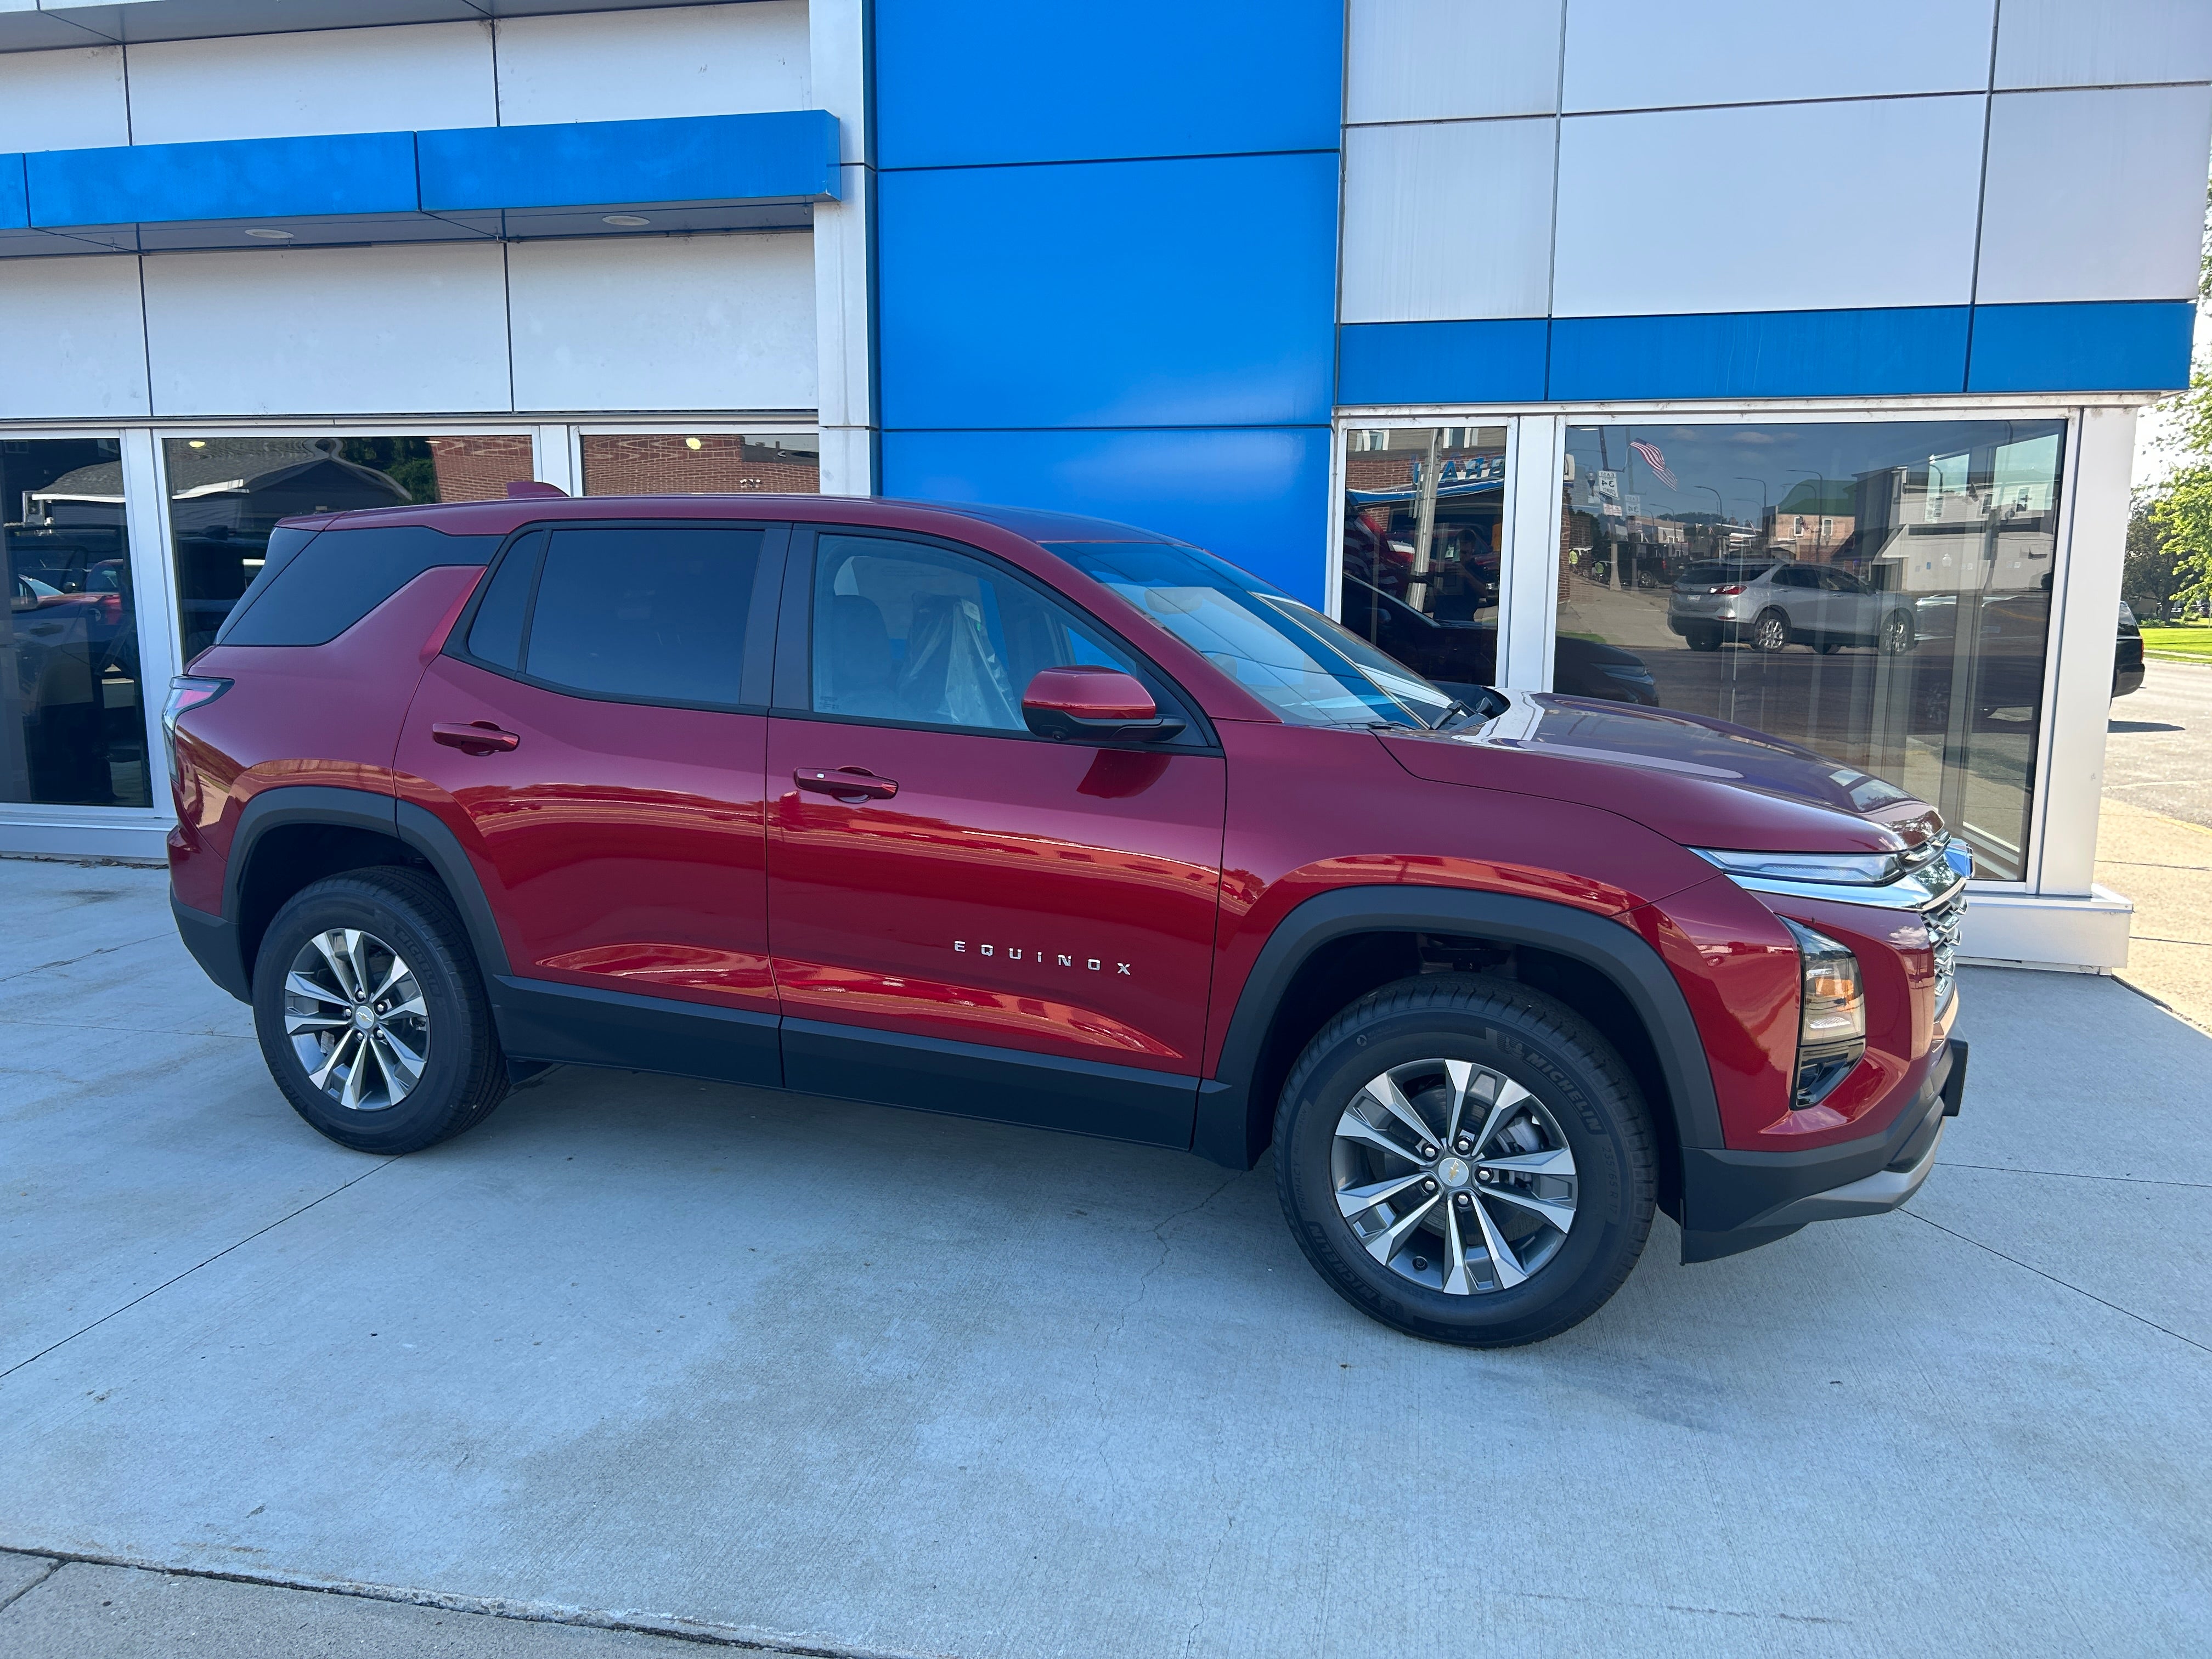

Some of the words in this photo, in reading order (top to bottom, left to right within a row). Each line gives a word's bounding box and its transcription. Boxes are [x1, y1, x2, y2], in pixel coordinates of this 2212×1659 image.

[954, 940, 1131, 975] EQUINOX
[1526, 1053, 1602, 1130] MICHELIN
[1294, 1160, 1308, 1211] PRIMACY
[1602, 1145, 1618, 1187] 235/65
[1609, 1190, 1618, 1199] R
[1609, 1203, 1618, 1215] 17
[1309, 1225, 1378, 1300] MICHELIN
